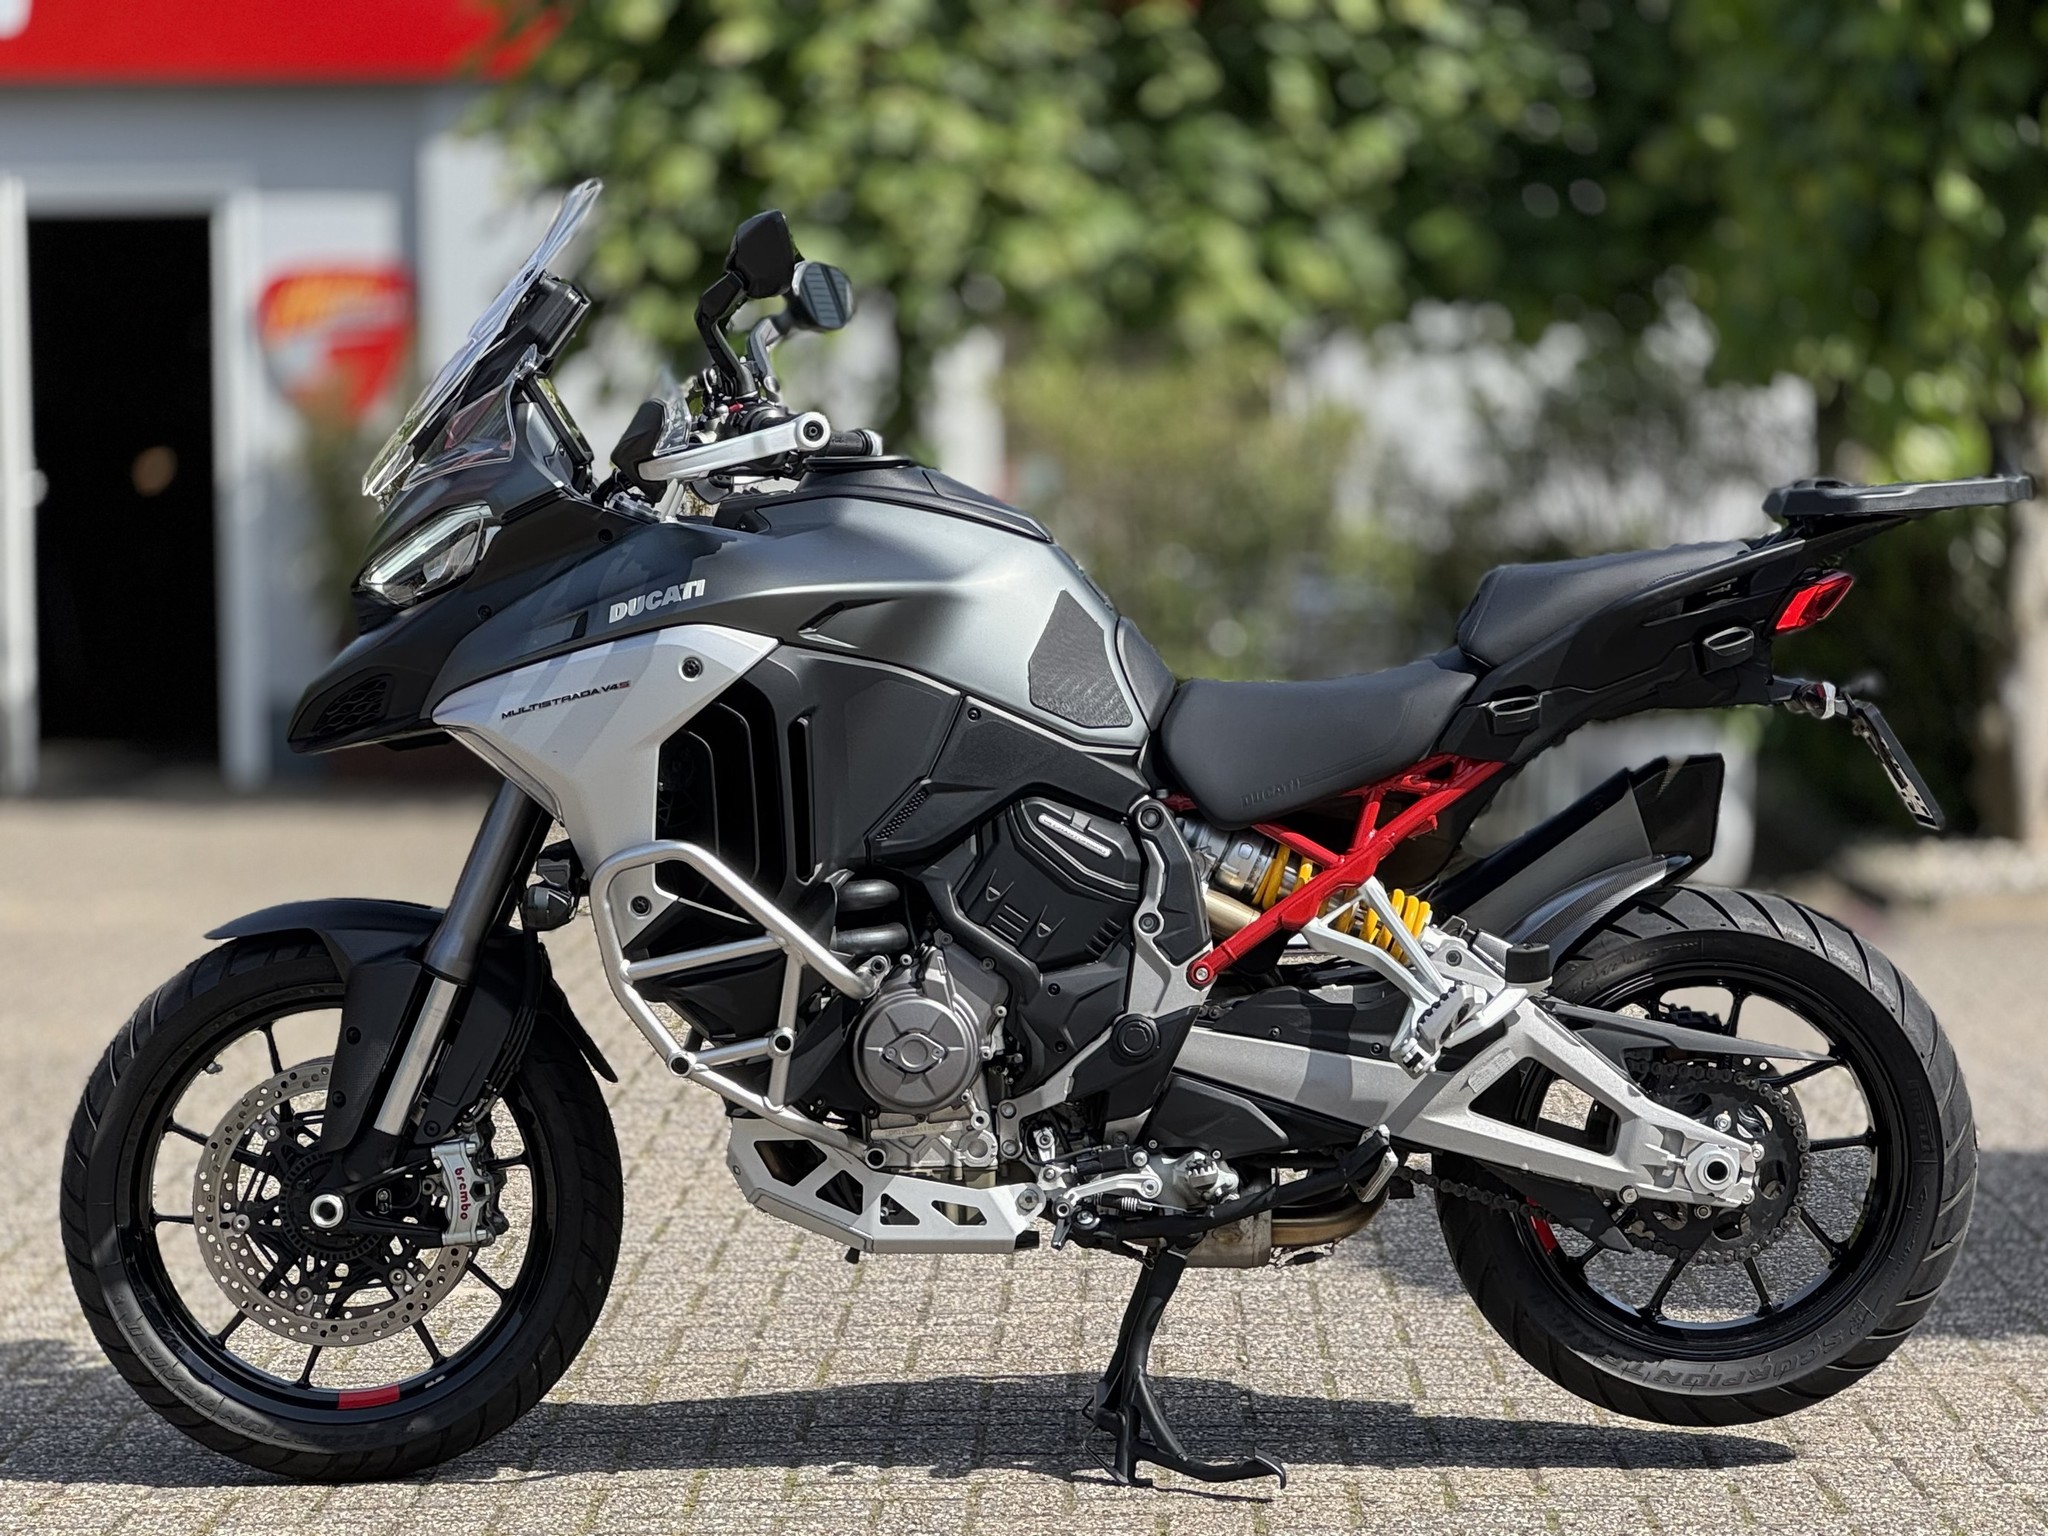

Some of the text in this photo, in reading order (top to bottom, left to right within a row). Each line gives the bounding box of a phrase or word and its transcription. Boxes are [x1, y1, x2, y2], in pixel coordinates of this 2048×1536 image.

[609, 579, 706, 624] DUCATI
[501, 680, 631, 720] MULTISTRADA V4S
[1241, 777, 1301, 809] DUCATI
[455, 1167, 471, 1220] brembo
[1651, 1331, 1844, 1387] SCORPION
